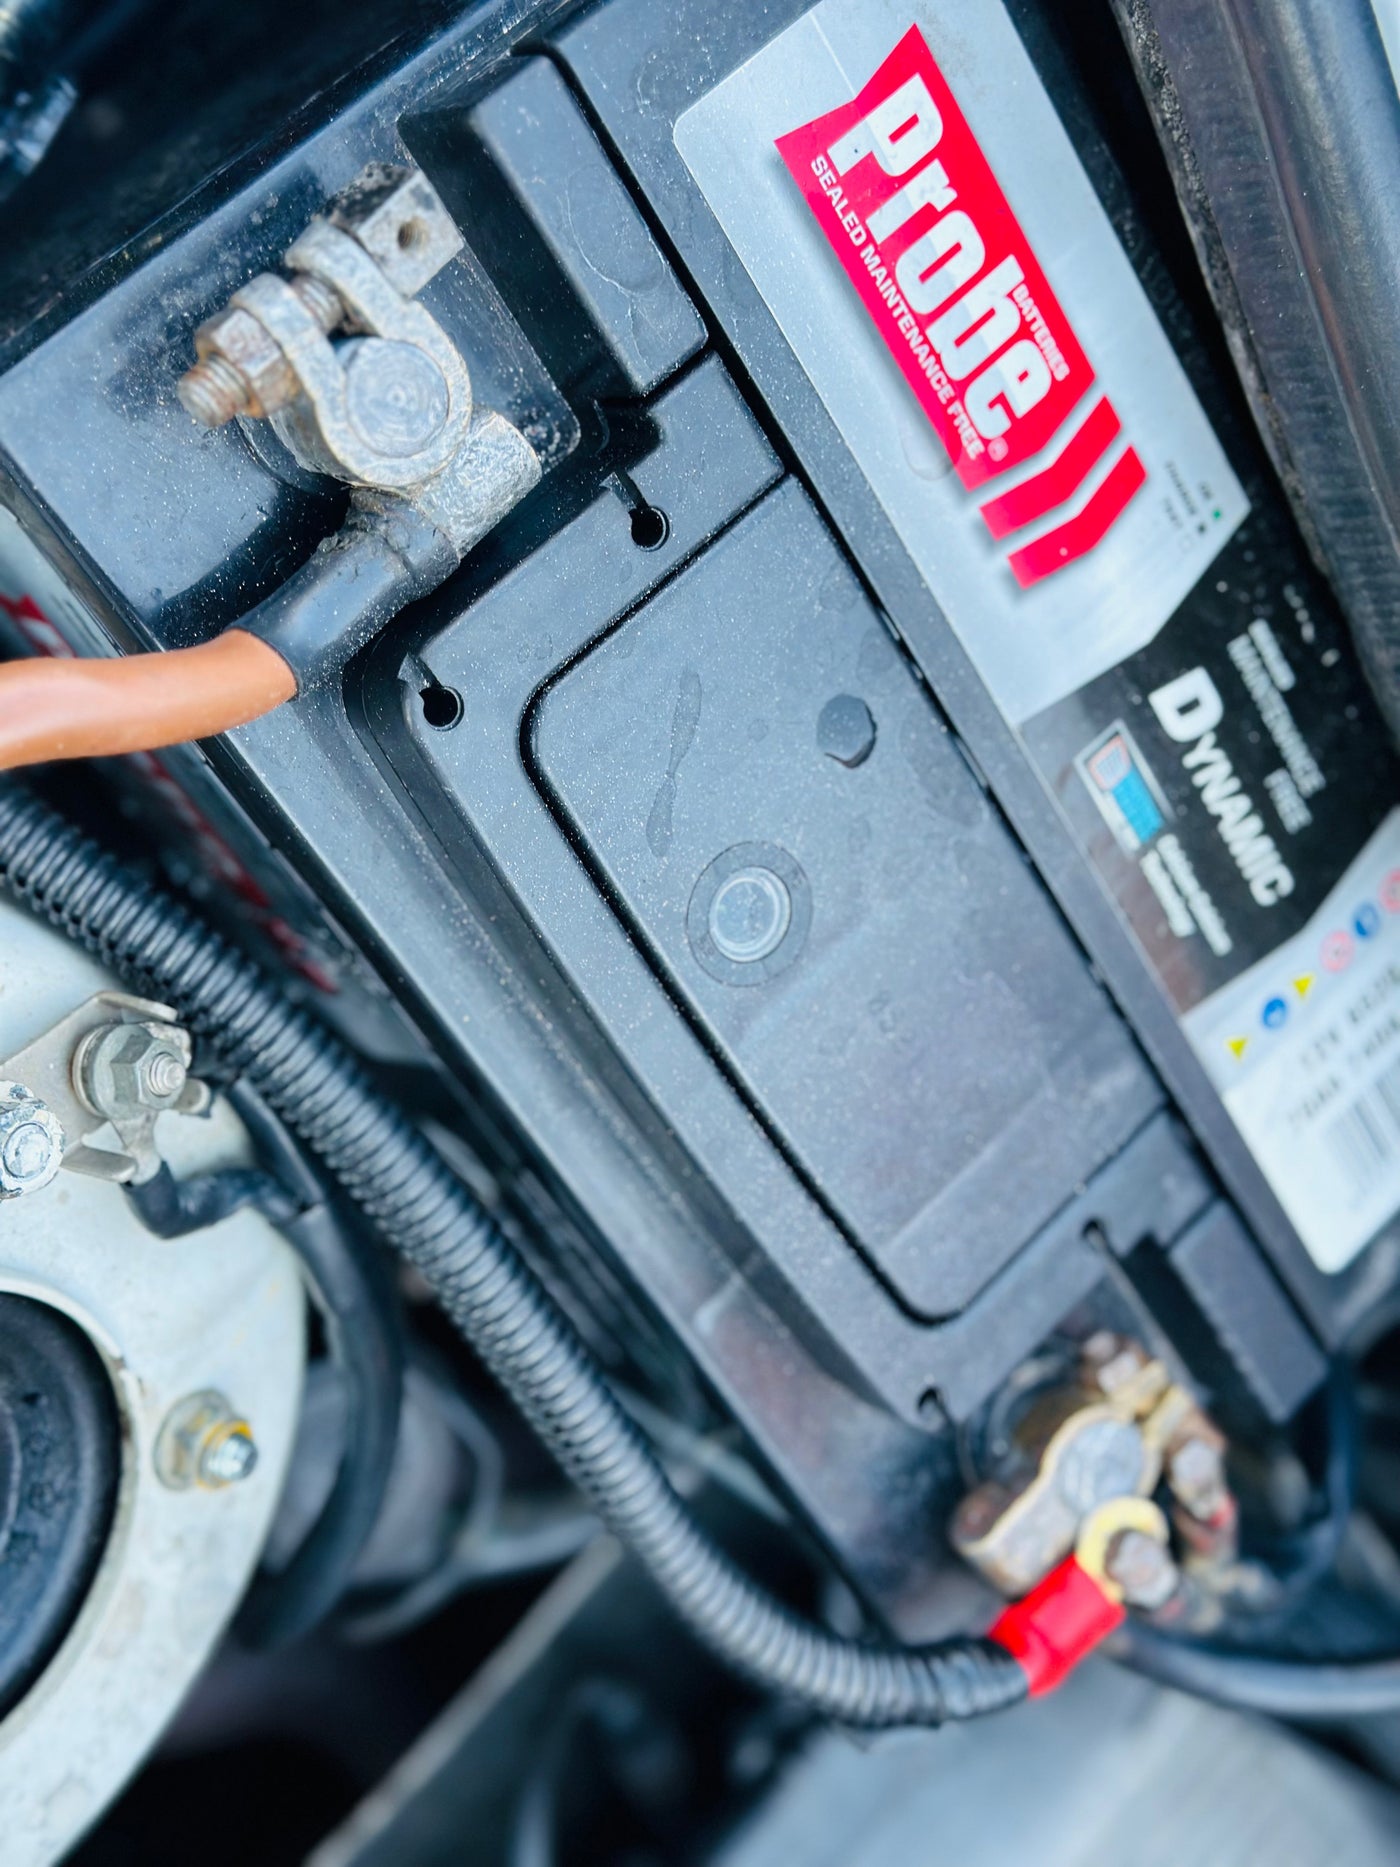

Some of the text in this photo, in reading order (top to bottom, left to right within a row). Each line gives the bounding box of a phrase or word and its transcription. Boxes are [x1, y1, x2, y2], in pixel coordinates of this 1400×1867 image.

[811, 156, 986, 461] SEALED MAINTENANCE FREE
[828, 72, 1052, 440] Probe
[1012, 283, 1071, 382] BATTERIES
[1148, 666, 1294, 906] DYNAMIC
